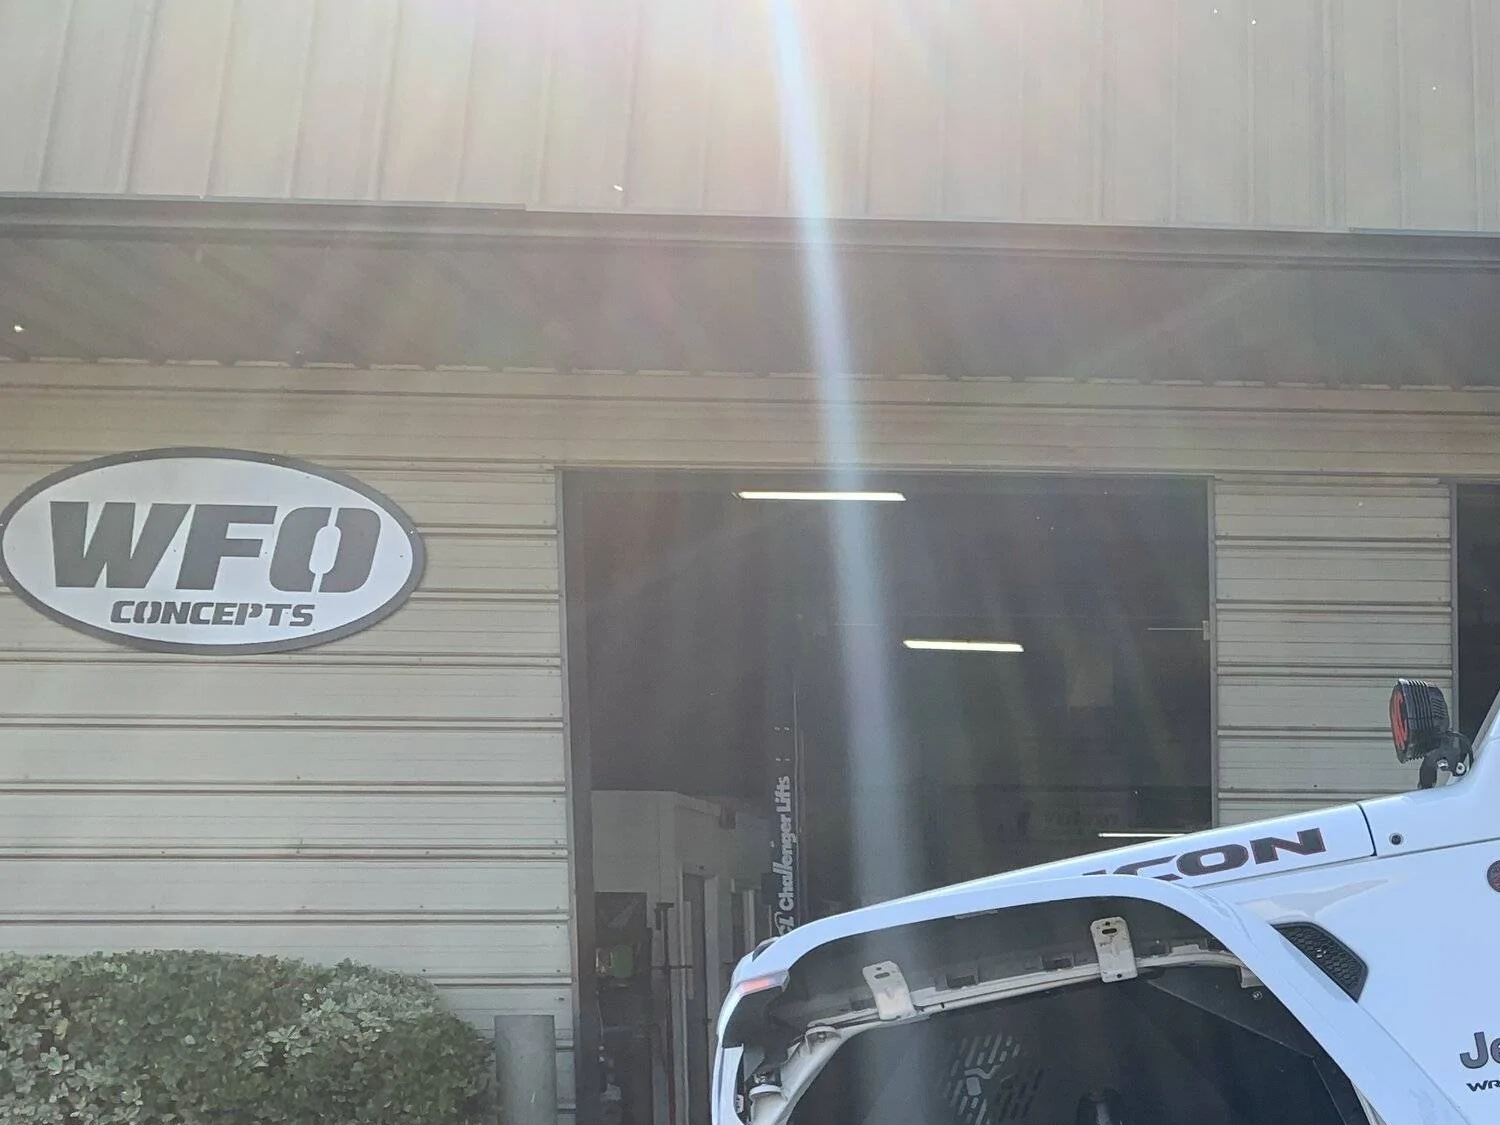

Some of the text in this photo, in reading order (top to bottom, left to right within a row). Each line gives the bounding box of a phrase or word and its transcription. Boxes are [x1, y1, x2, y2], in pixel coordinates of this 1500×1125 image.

[49, 501, 382, 593] WFO
[110, 600, 316, 628] CONCEPTS
[775, 775, 793, 813] Lifts
[772, 814, 797, 911] Challenger
